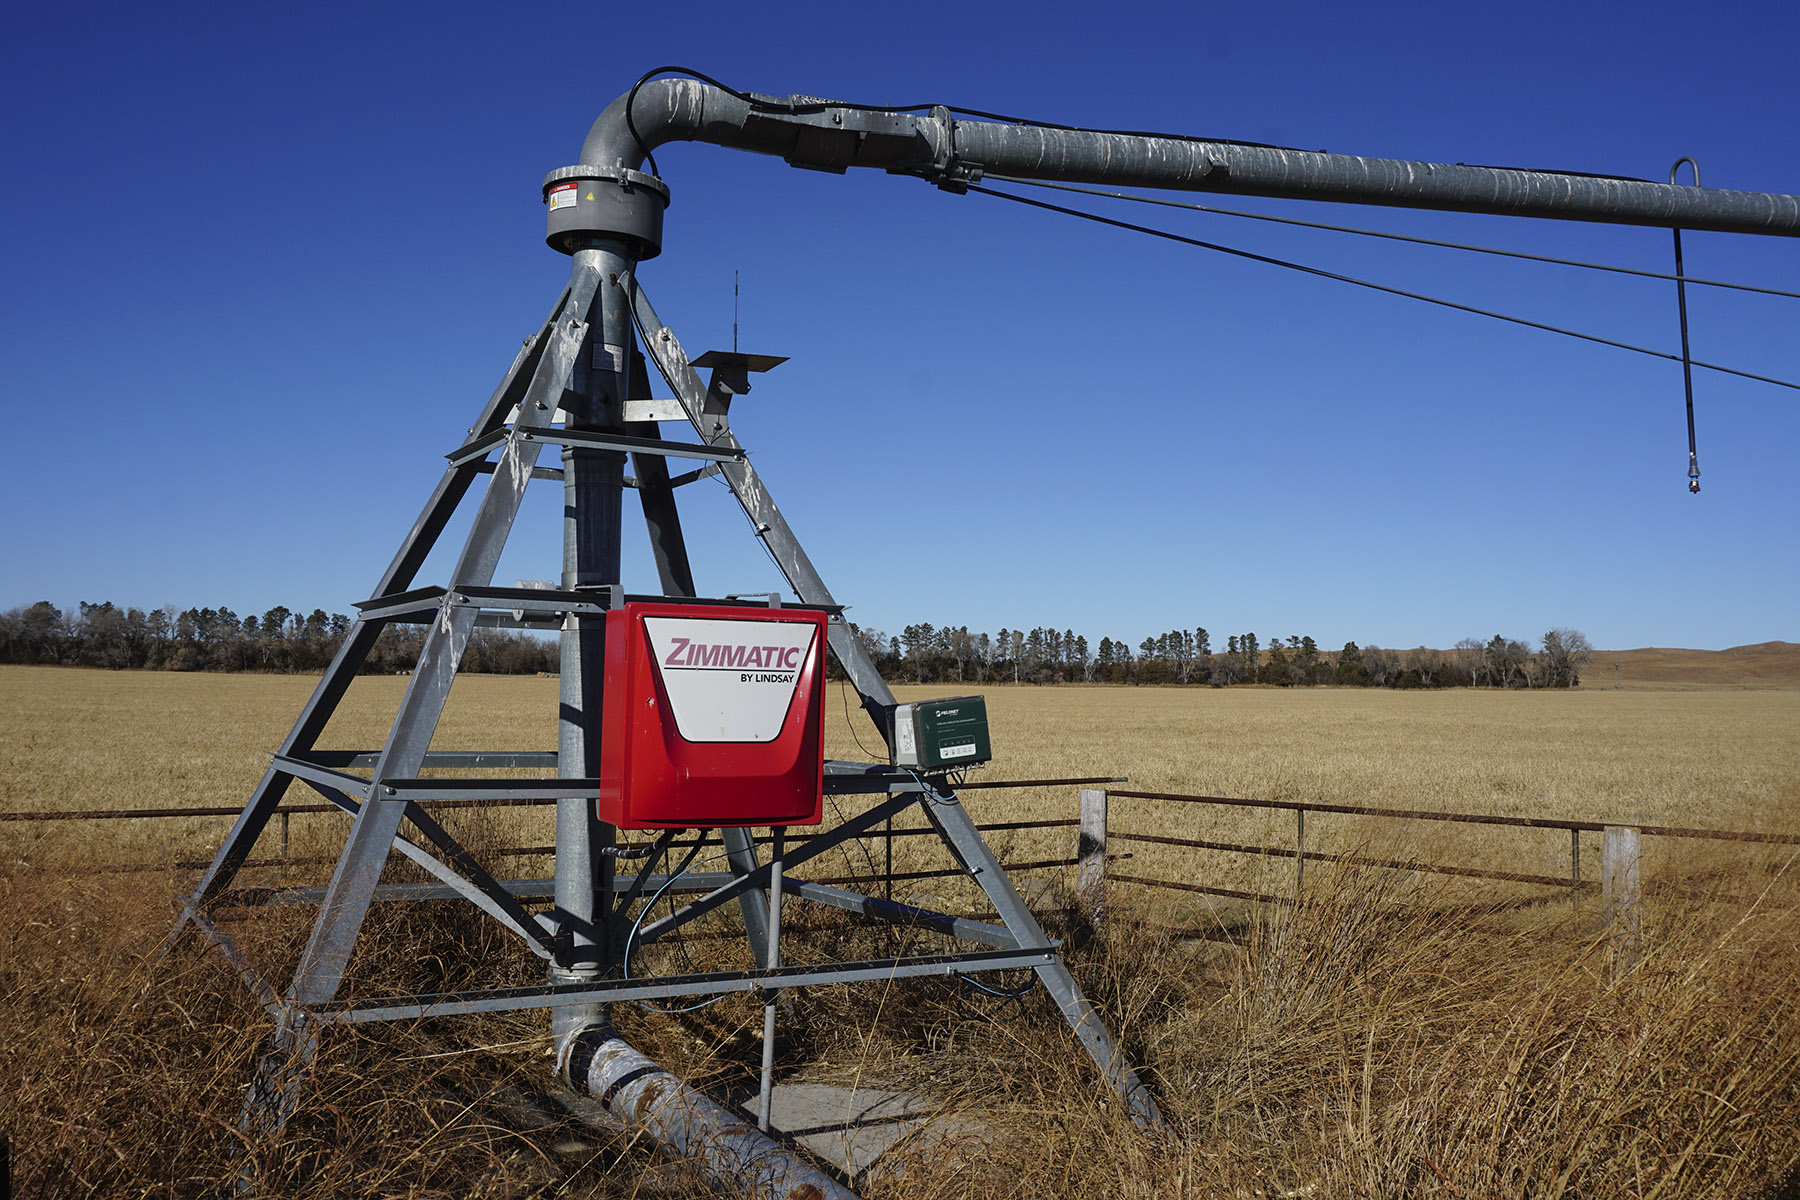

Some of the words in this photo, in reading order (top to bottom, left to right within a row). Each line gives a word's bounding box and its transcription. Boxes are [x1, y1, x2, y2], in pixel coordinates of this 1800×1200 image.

[665, 638, 799, 668] ZIMMATIC
[741, 674, 753, 682] BY
[755, 674, 794, 683] LINDSAY
